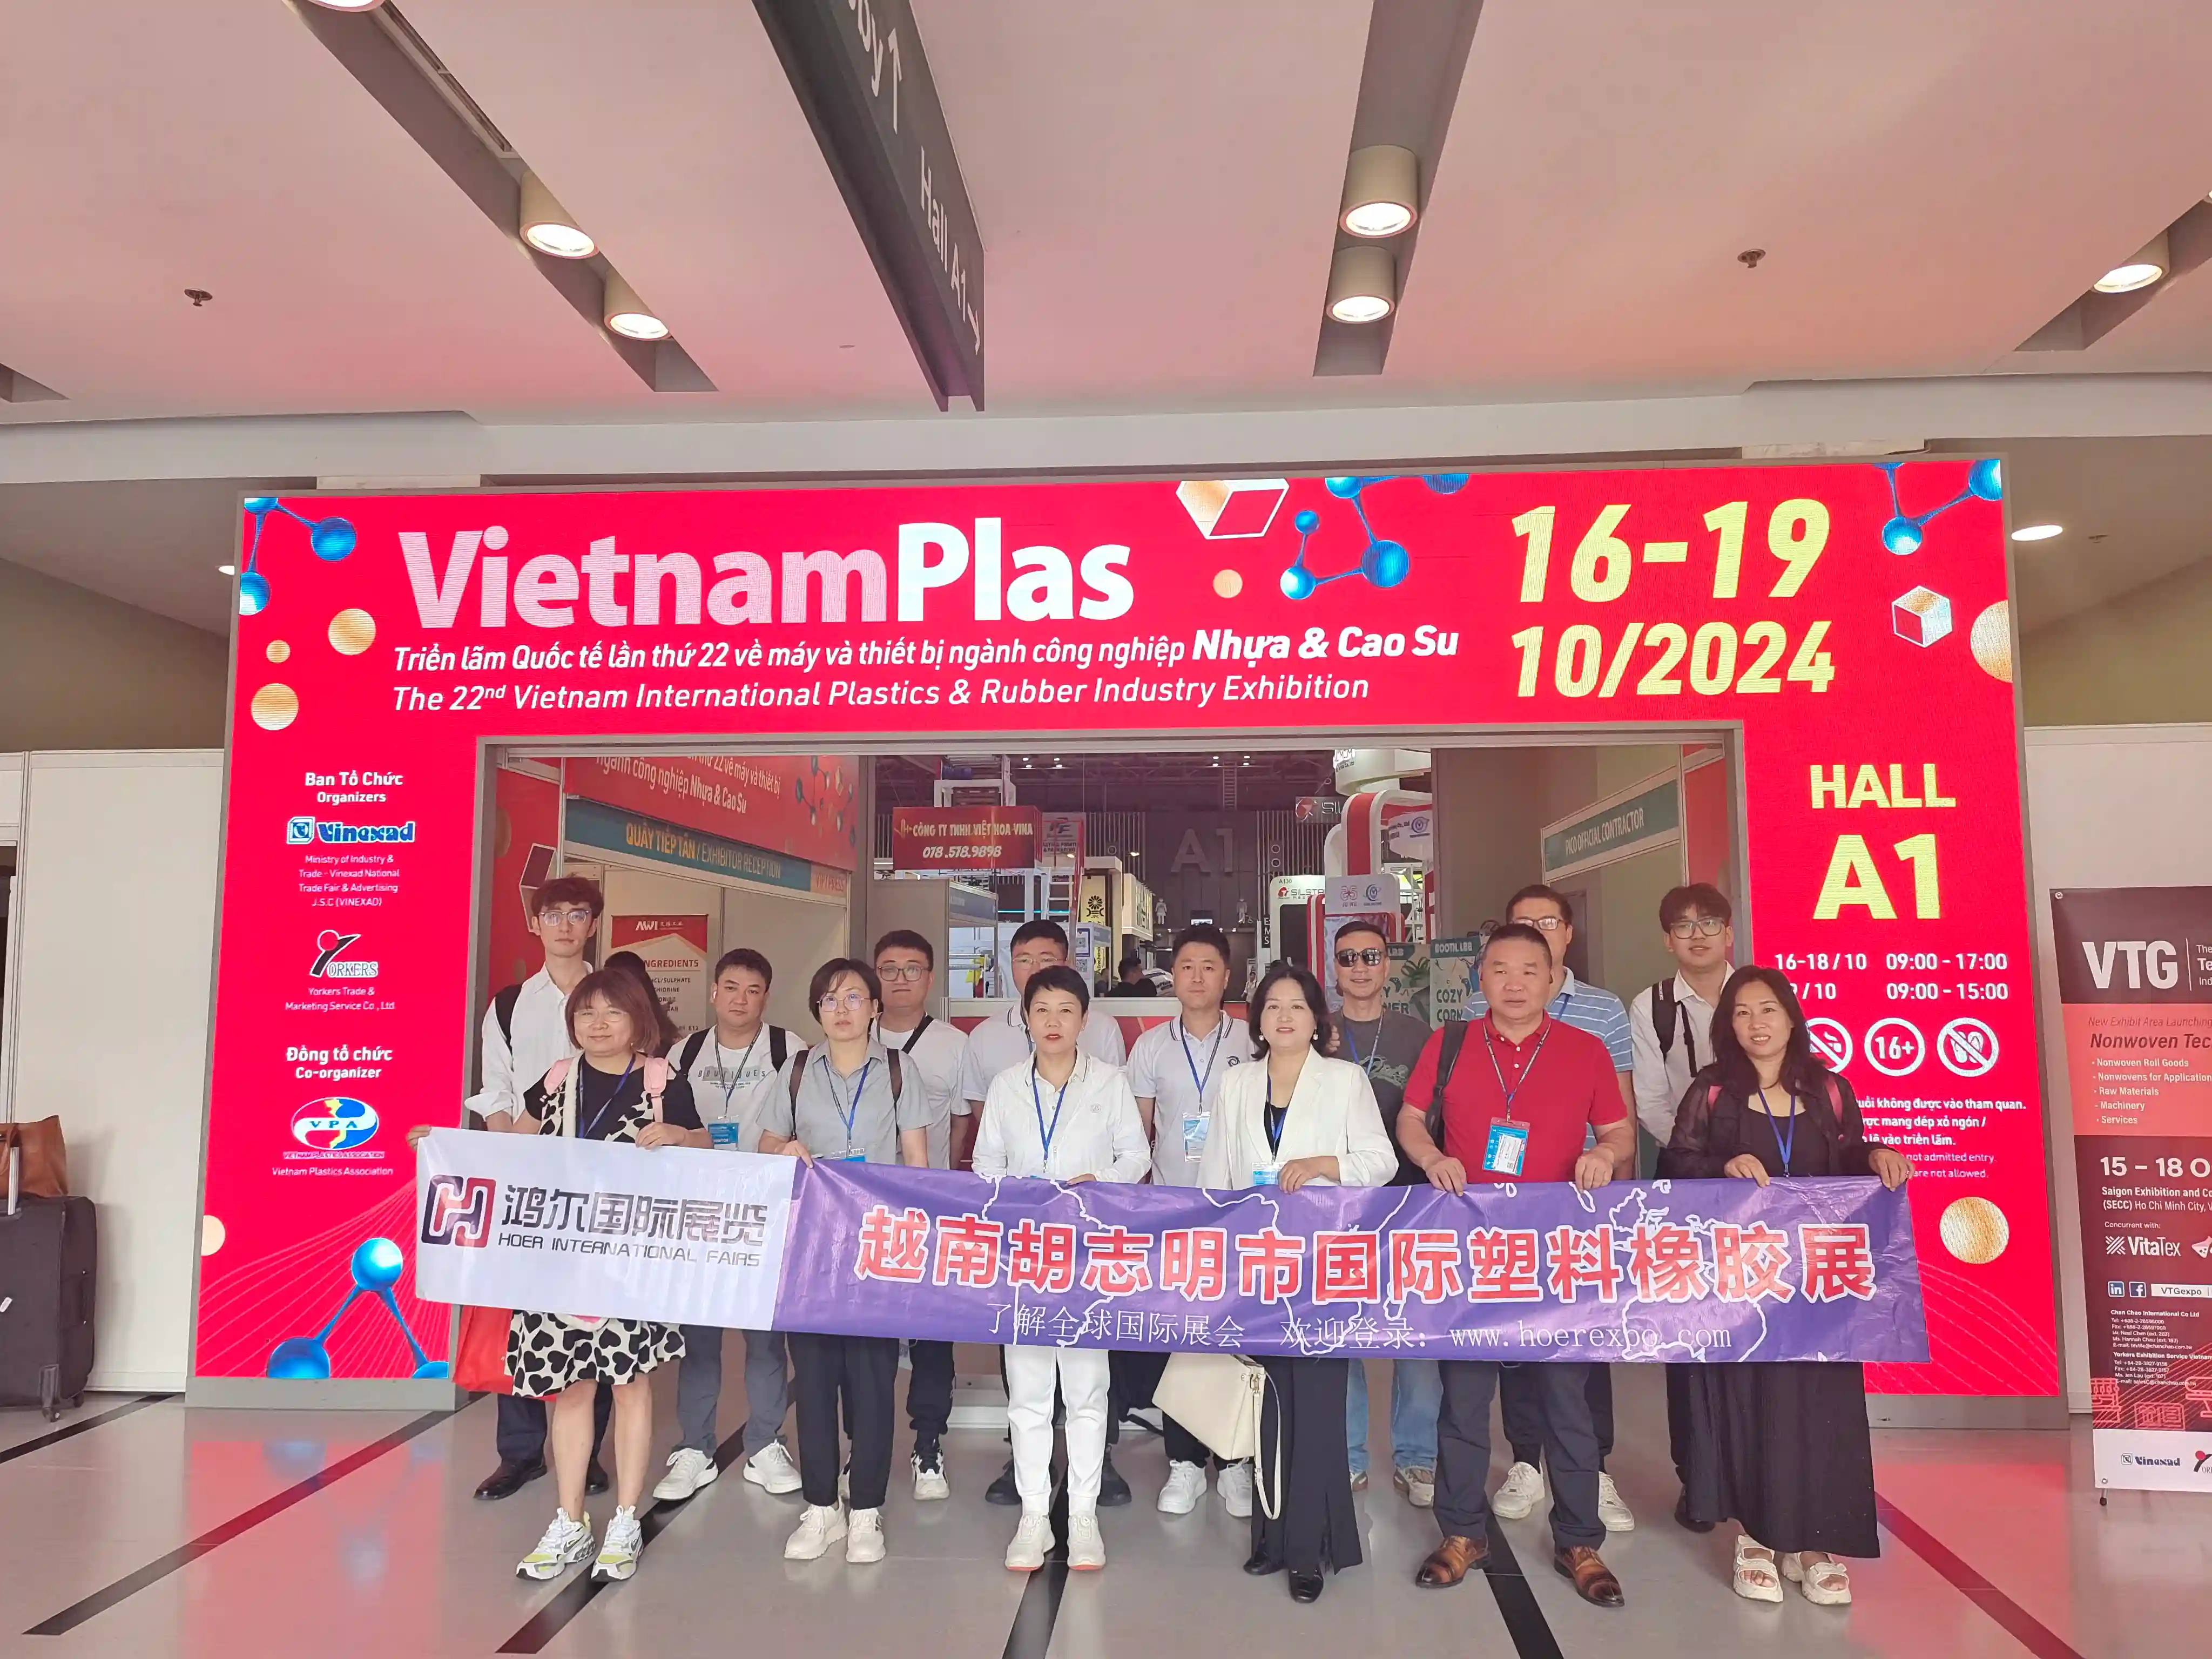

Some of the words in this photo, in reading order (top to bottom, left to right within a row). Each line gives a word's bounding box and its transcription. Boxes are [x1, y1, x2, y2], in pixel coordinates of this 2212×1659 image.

[921, 145, 948, 273] Hall
[951, 243, 966, 322] A1
[1512, 498, 1830, 603] 16-19
[398, 517, 1134, 628] VietnamPlas
[394, 643, 455, 671] Triển
[461, 645, 506, 671] lãm
[512, 641, 572, 671] Quốc
[579, 640, 603, 669] tế
[608, 639, 645, 669] lần
[651, 641, 698, 669] thứ
[698, 642, 728, 668] 22
[734, 638, 764, 668] về
[767, 642, 819, 673] máy
[825, 640, 853, 665] và
[858, 637, 917, 665] thiết
[921, 639, 944, 671] bị
[949, 638, 1027, 673] ngành
[1032, 637, 1091, 670] công
[1097, 636, 1185, 669] nghiệp
[1192, 629, 1291, 669] Nhựa
[1298, 627, 1330, 659] &
[1338, 626, 1405, 658] Cao
[1411, 624, 1460, 657] Su
[1512, 621, 1835, 698] 10/2024
[394, 686, 443, 711] The
[451, 684, 508, 710] 22nd
[514, 683, 629, 709] Vietnam
[636, 680, 820, 709] International
[828, 679, 940, 705] Plastics
[948, 679, 972, 704] &
[981, 678, 1088, 704] Rubber
[1094, 677, 1216, 708] Industry
[1222, 673, 1370, 701] Exhibition
[305, 772, 335, 786] Ban
[339, 770, 359, 786] Tổ
[362, 771, 404, 786] Chức
[632, 758, 657, 790] công
[658, 766, 689, 800] nghiệp
[690, 774, 713, 807] Nhựa
[713, 784, 721, 806] &
[722, 785, 737, 811] Cao
[737, 792, 747, 814] Su
[1810, 763, 1957, 809] HALL
[316, 791, 387, 806] Organizers
[913, 821, 935, 837] CÔNG
[939, 824, 949, 836] TY
[1566, 835, 1577, 857] PICO
[1577, 826, 1602, 852] OFFICIAL
[1601, 807, 1645, 842] CONTRACTOR
[677, 832, 696, 860] TÂN
[701, 842, 745, 871] EXHIBITOR
[743, 852, 781, 880] RECEPTION
[1170, 828, 1235, 874] A1
[305, 854, 339, 866] Ministry
[340, 854, 350, 864] of
[350, 854, 385, 865] Industry
[299, 869, 323, 878] Trade
[329, 869, 363, 878] Vinexad
[364, 868, 400, 878] National
[1813, 833, 1941, 920] A1
[299, 883, 323, 892] Trade
[324, 883, 340, 892] Fair
[350, 883, 399, 894] Advertising
[335, 897, 383, 907] (VINEXAD)
[644, 959, 699, 967] NGREDIENTS
[1775, 953, 1830, 970] 16-18
[1844, 953, 1868, 970] 10
[1886, 953, 1938, 970] 09:00
[1955, 953, 2008, 970] 17:00
[2082, 940, 2179, 989] VTG
[308, 987, 341, 996] Yorkers
[342, 987, 367, 996] Trade
[1436, 989, 1463, 1003] COZY
[1815, 982, 1837, 1000] 10
[1886, 983, 1939, 1000] 09:00
[1956, 983, 2009, 1000] 15:00
[285, 1001, 328, 1013] Marketing
[330, 1001, 362, 1010] Service
[2088, 1017, 2108, 1027] New
[2110, 1016, 2141, 1027] Exhibit
[2143, 1016, 2163, 1027] Area
[1874, 1036, 1915, 1060] 16+
[2090, 1033, 2178, 1049] Nonwoven
[333, 1043, 349, 1061] tổ
[353, 1045, 393, 1062] chức
[2096, 1058, 2141, 1067] Nonwoven
[2143, 1058, 2160, 1067] Roll
[2162, 1058, 2189, 1067] Goods
[295, 1066, 382, 1082] Co-organizer
[2098, 1073, 2147, 1081] Nonwovens
[2149, 1073, 2161, 1081] for
[2099, 1087, 2117, 1095] Raw
[2119, 1087, 2159, 1096] Materials
[1877, 1097, 1912, 1111] không
[1913, 1097, 1943, 1111] được
[1944, 1097, 1963, 1109] vào
[1965, 1098, 1993, 1109] tham
[1995, 1100, 2027, 1112] quan.
[2100, 1101, 2145, 1112] Machinery
[1881, 1117, 1912, 1130] mang
[1913, 1116, 1934, 1130] dép
[1936, 1115, 1950, 1127] xỏ
[1952, 1116, 1980, 1130] ngón
[2101, 1115, 2138, 1124] Services
[1881, 1134, 1901, 1145] vào
[1904, 1132, 1930, 1145] triển
[1932, 1134, 1956, 1145] lãm.
[1906, 1153, 1923, 1162] not
[1924, 1152, 1967, 1162] admitted
[272, 1166, 307, 1176] Vietnam
[308, 1166, 342, 1176] Plastics
[343, 1166, 394, 1176] Association
[2100, 1156, 2127, 1176] 15
[2155, 1157, 2183, 1177] 18
[2102, 1186, 2133, 1197] Saigon
[2135, 1187, 2180, 1197] Exhibition
[2183, 1188, 2200, 1197] and
[2103, 1199, 2133, 1211] (SECC)
[2135, 1201, 2147, 1210] Ho
[2148, 1201, 2162, 1210] Chi
[2164, 1201, 2186, 1211] Minh
[2188, 1201, 2206, 1213] City,
[501, 1184, 768, 1247] 鸿尔国际展览
[498, 1232, 544, 1250] HOER
[551, 1236, 697, 1263] INTERNATIONAL
[706, 1250, 760, 1267] FAIRS
[2127, 1236, 2181, 1257] VitaTex
[855, 1204, 1877, 1306] 越南胡志明市国际塑料橡胶展
[2161, 1287, 2202, 1296] VTGexpo
[986, 1303, 1245, 1348] 了解全球国际展会
